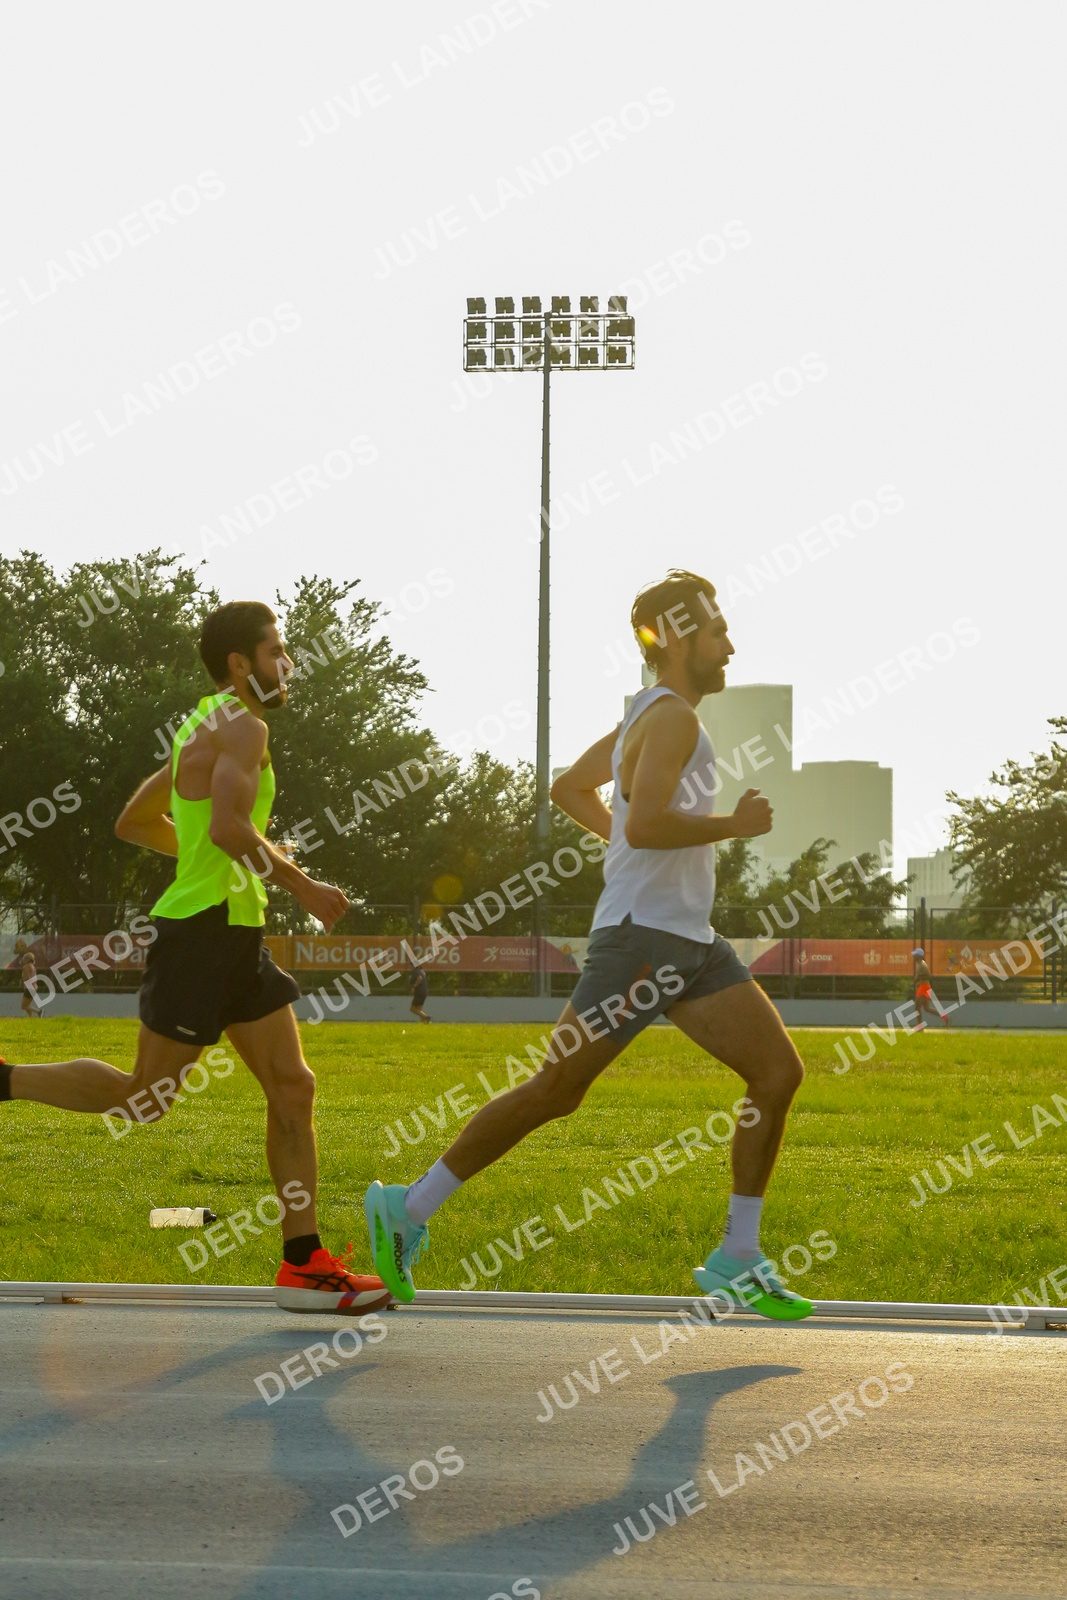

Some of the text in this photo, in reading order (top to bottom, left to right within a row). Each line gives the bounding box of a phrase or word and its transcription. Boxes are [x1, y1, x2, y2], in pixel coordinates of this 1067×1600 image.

[295, 941, 407, 963] Nacional
[414, 945, 460, 964] 2026
[393, 1232, 408, 1283] BROOKS
